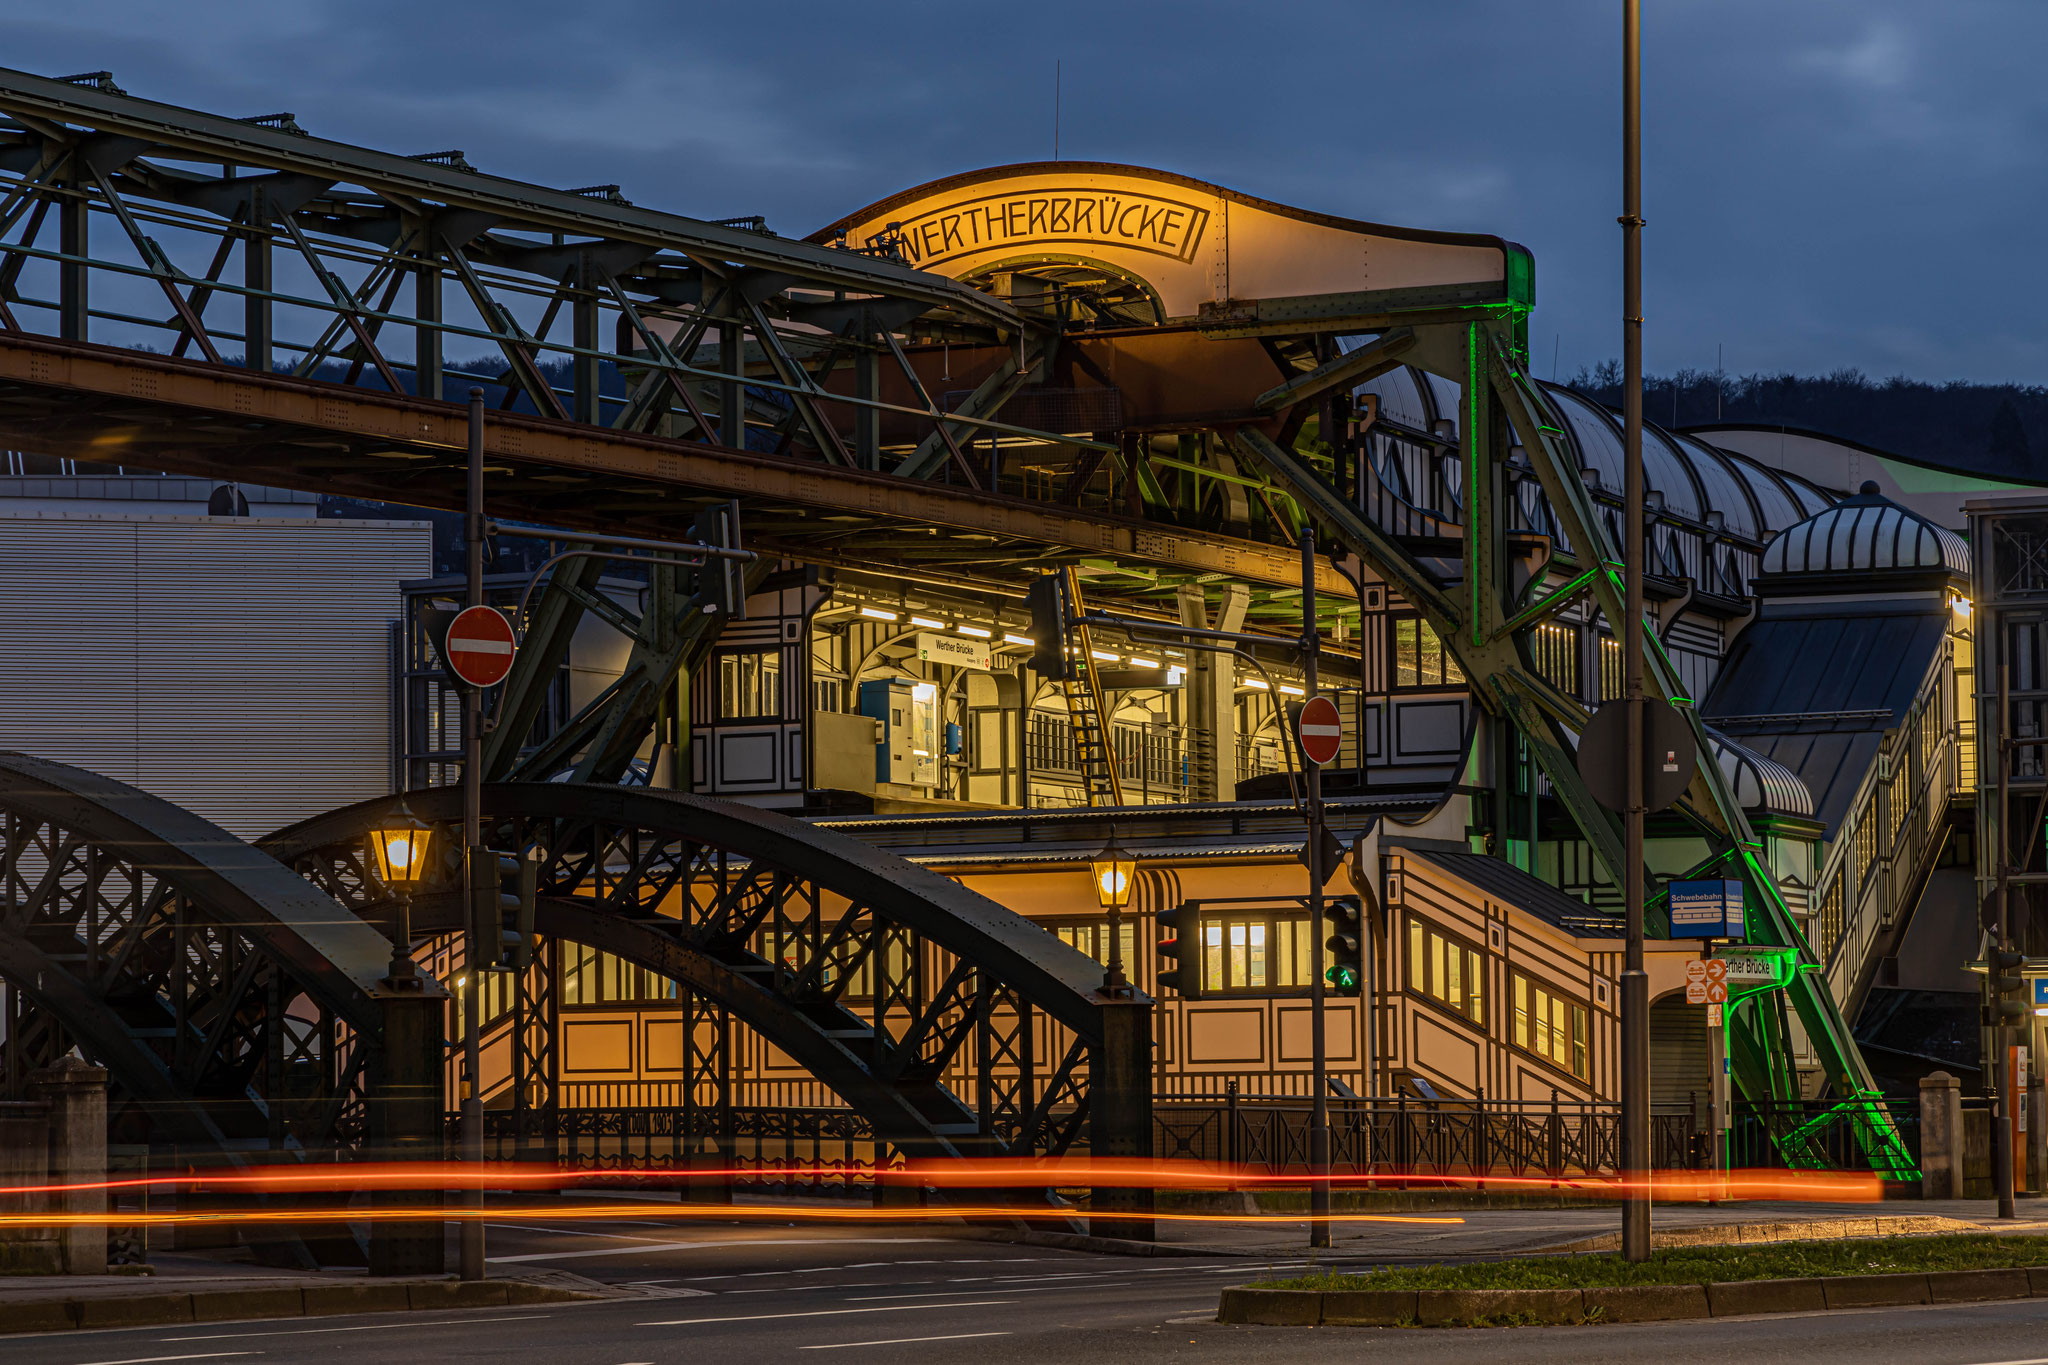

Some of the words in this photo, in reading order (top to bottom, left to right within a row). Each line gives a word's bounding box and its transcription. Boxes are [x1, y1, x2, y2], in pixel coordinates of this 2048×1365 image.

[936, 639, 955, 652] Werther
[956, 642, 974, 656] Brücke
[1671, 893, 1722, 902] Schwebebahn
[1718, 957, 1744, 973] erther
[1746, 958, 1770, 974] Brücke
